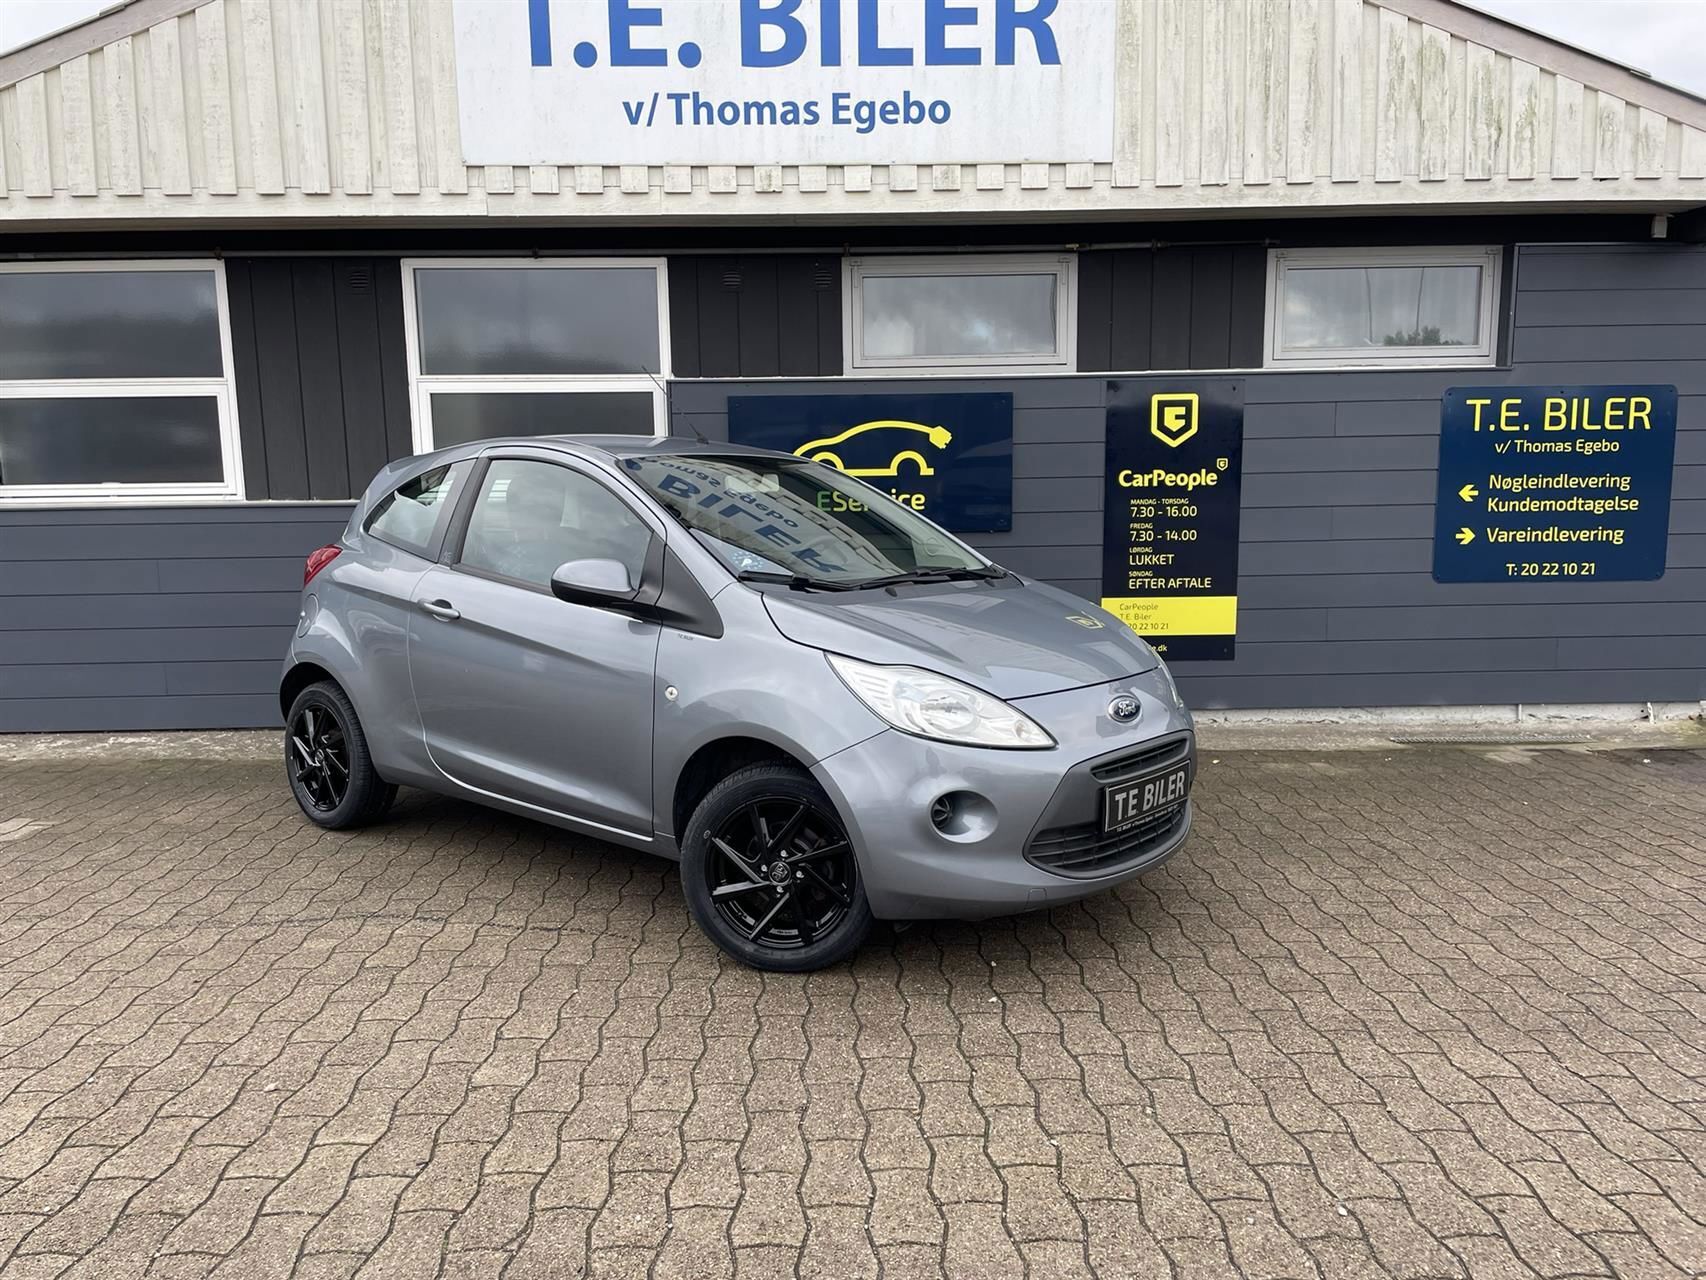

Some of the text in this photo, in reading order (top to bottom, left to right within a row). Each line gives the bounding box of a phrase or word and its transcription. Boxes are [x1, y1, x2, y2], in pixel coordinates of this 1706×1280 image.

[739, 0, 1062, 69] BILER
[622, 91, 951, 134] v/ Thomas Egebo
[1465, 397, 1653, 432] T.E. BILER
[1495, 438, 1620, 455] v/ Thomas Egebo
[1118, 468, 1218, 491] CarPeople
[1489, 473, 1632, 493] Nøgleindlevering
[1130, 506, 1155, 518] 7.30
[1166, 506, 1198, 517] 16.00
[1487, 496, 1640, 515] Kundemodtagelse
[1129, 530, 1154, 542] 7.30
[1165, 530, 1198, 541] 14.00
[1486, 526, 1625, 545] Vareindlevering
[1129, 554, 1175, 566] LUKKET
[1505, 562, 1596, 576] T: 20 22 10 21
[1128, 577, 1212, 590] EFTER AFTALE
[1119, 603, 1159, 612] CarPeople
[1160, 622, 1169, 630] 21
[1142, 771, 1185, 812] BILER
